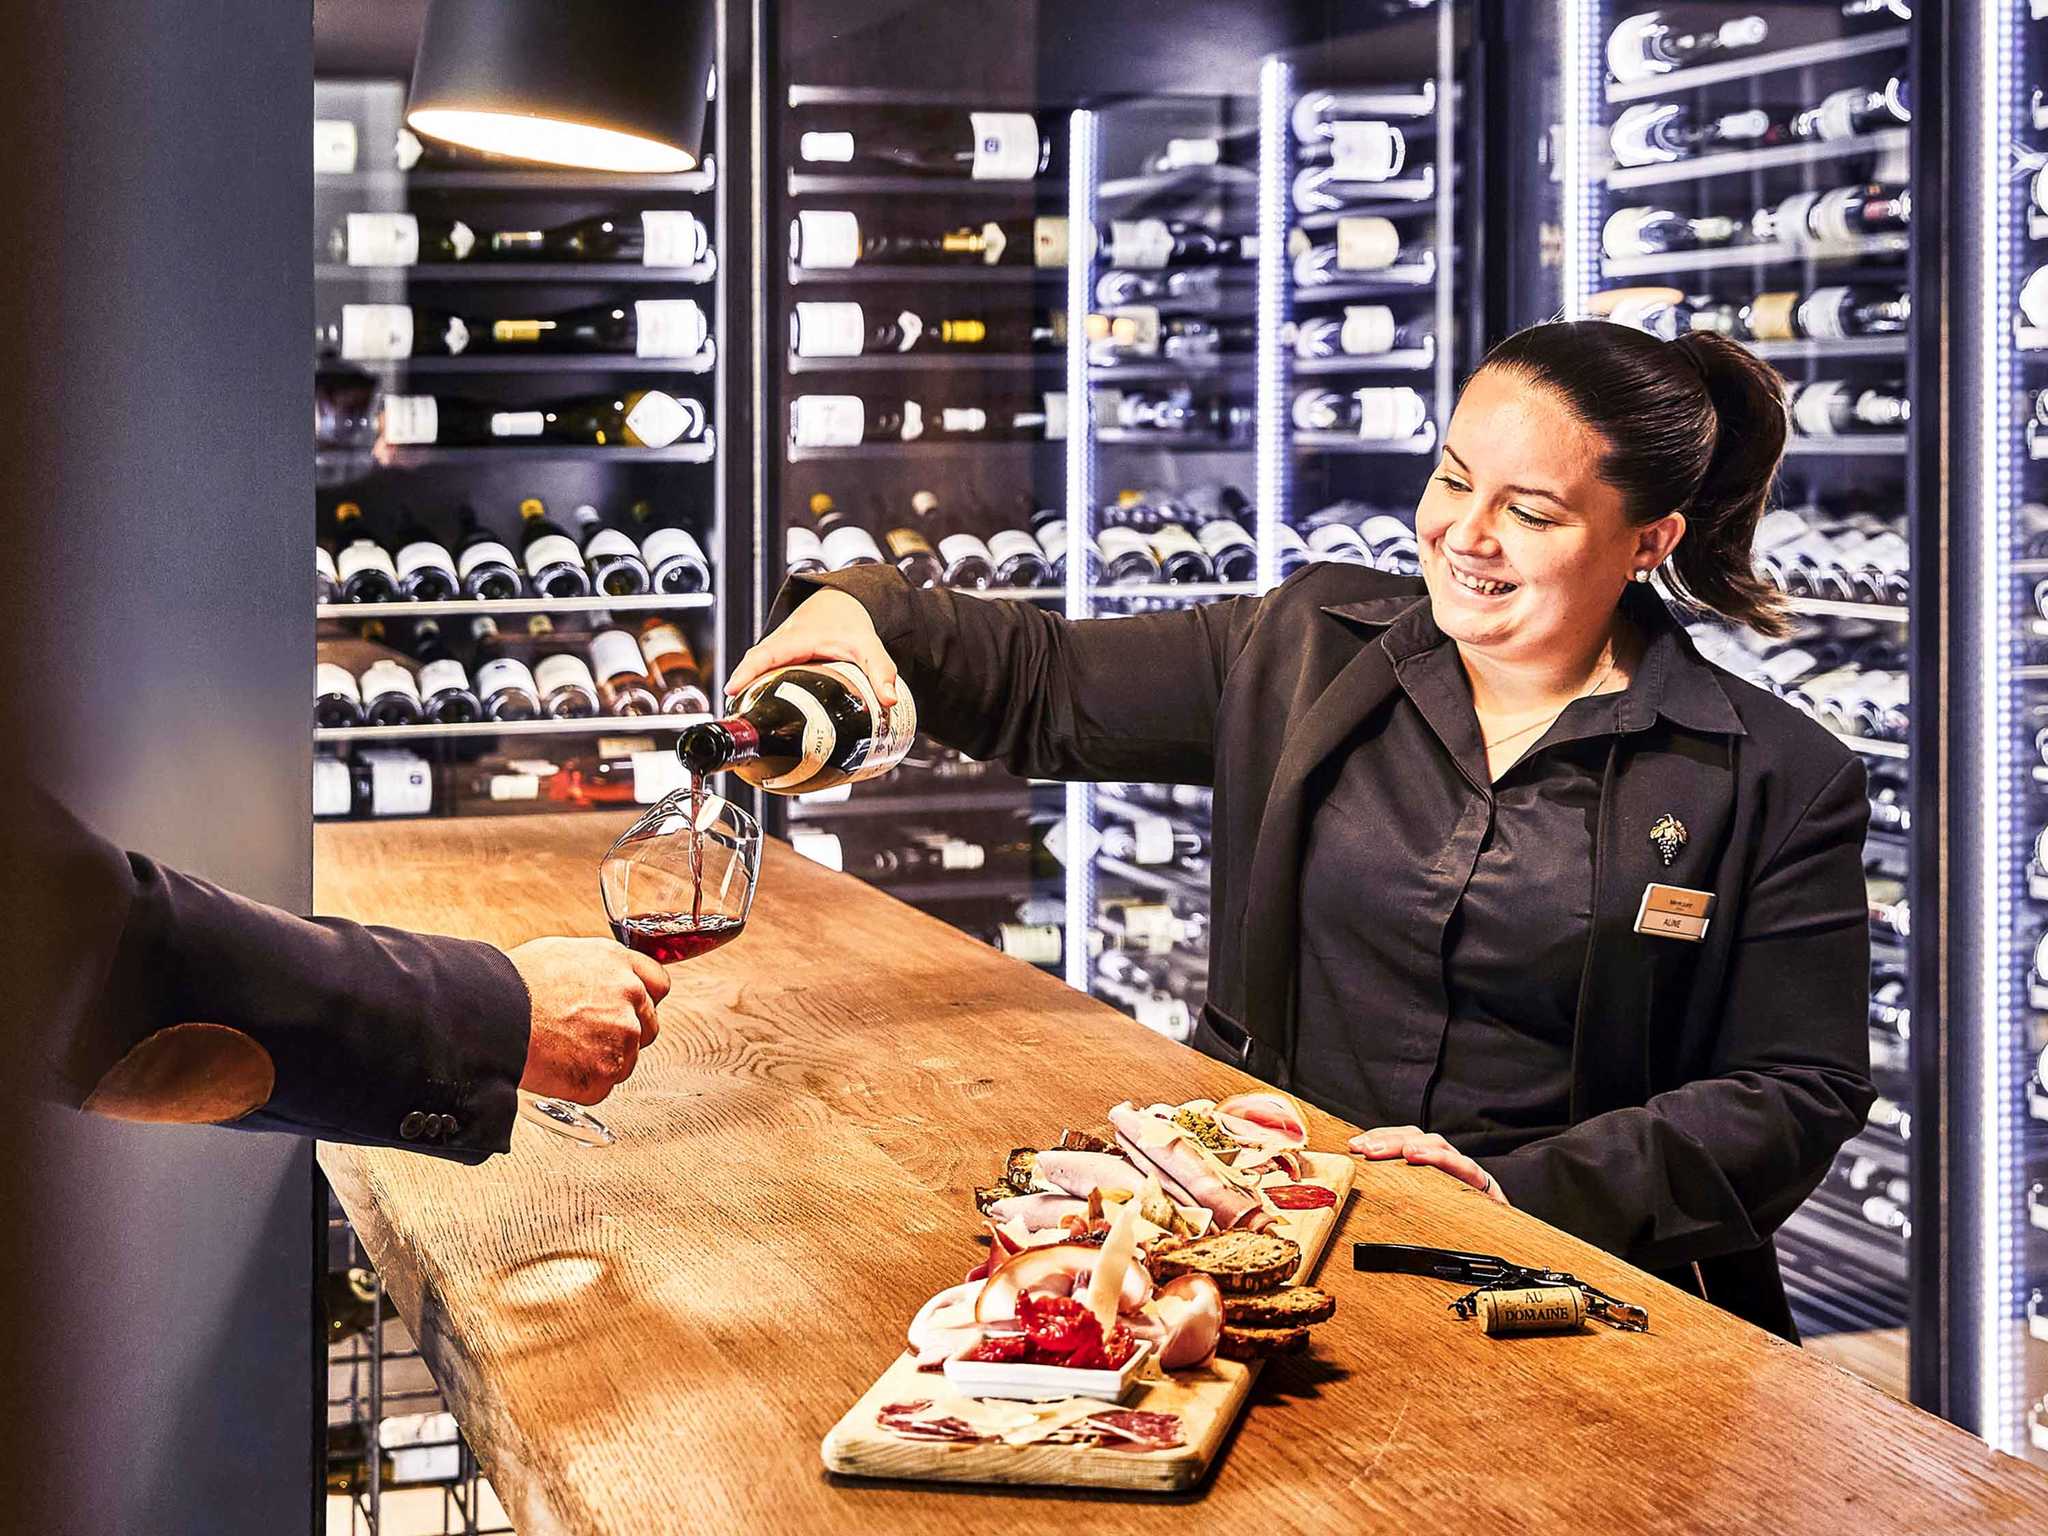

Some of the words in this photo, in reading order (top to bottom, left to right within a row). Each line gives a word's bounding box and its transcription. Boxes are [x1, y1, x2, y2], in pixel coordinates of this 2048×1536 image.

[814, 728, 824, 754] 2017
[1525, 1290, 1544, 1304] AU
[1504, 1306, 1569, 1321] DOMAINE
